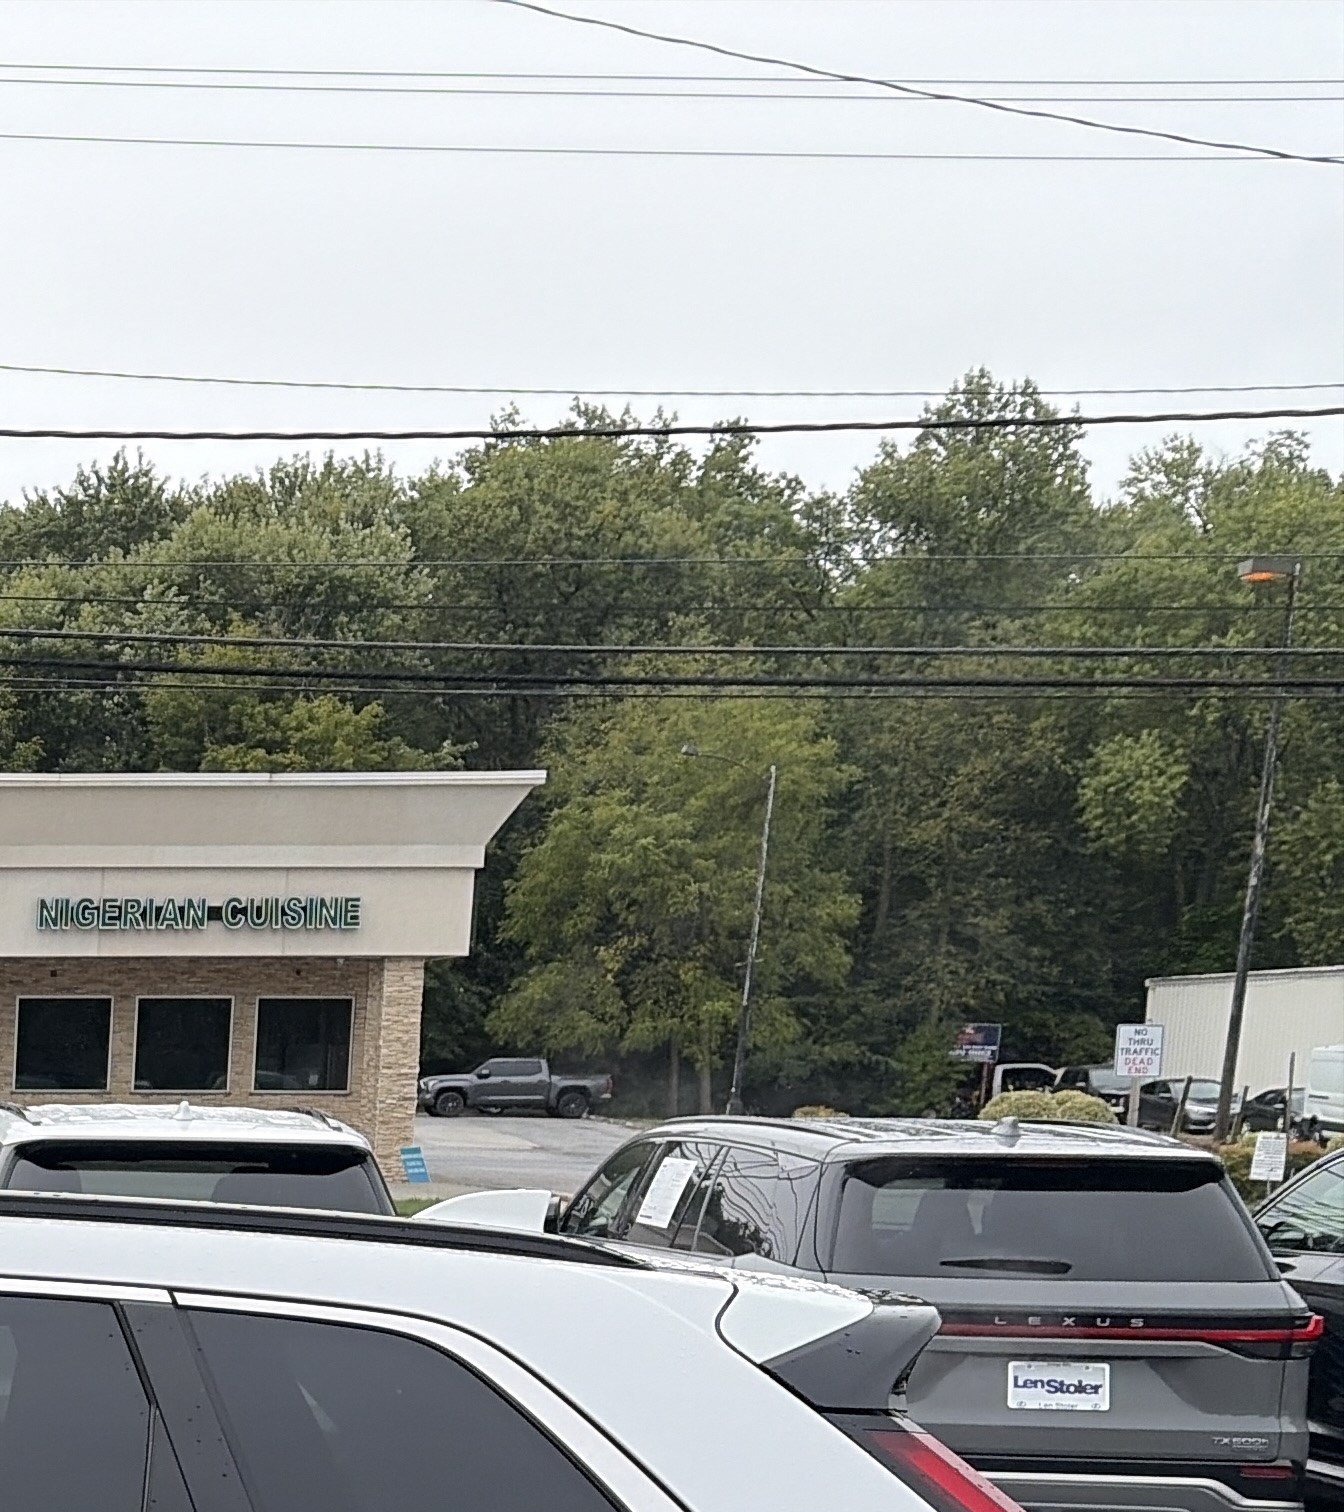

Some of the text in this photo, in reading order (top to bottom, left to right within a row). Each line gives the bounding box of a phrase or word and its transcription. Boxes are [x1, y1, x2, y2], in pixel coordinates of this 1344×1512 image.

[36, 897, 362, 930] NIGERIAN CUISINE
[1134, 1028, 1148, 1036] NO
[1128, 1037, 1154, 1046] THRU
[1120, 1047, 1160, 1056] TRAFFIC
[1124, 1057, 1154, 1066] DEAD
[1127, 1066, 1149, 1074] END
[994, 1316, 1145, 1328] LEXUS
